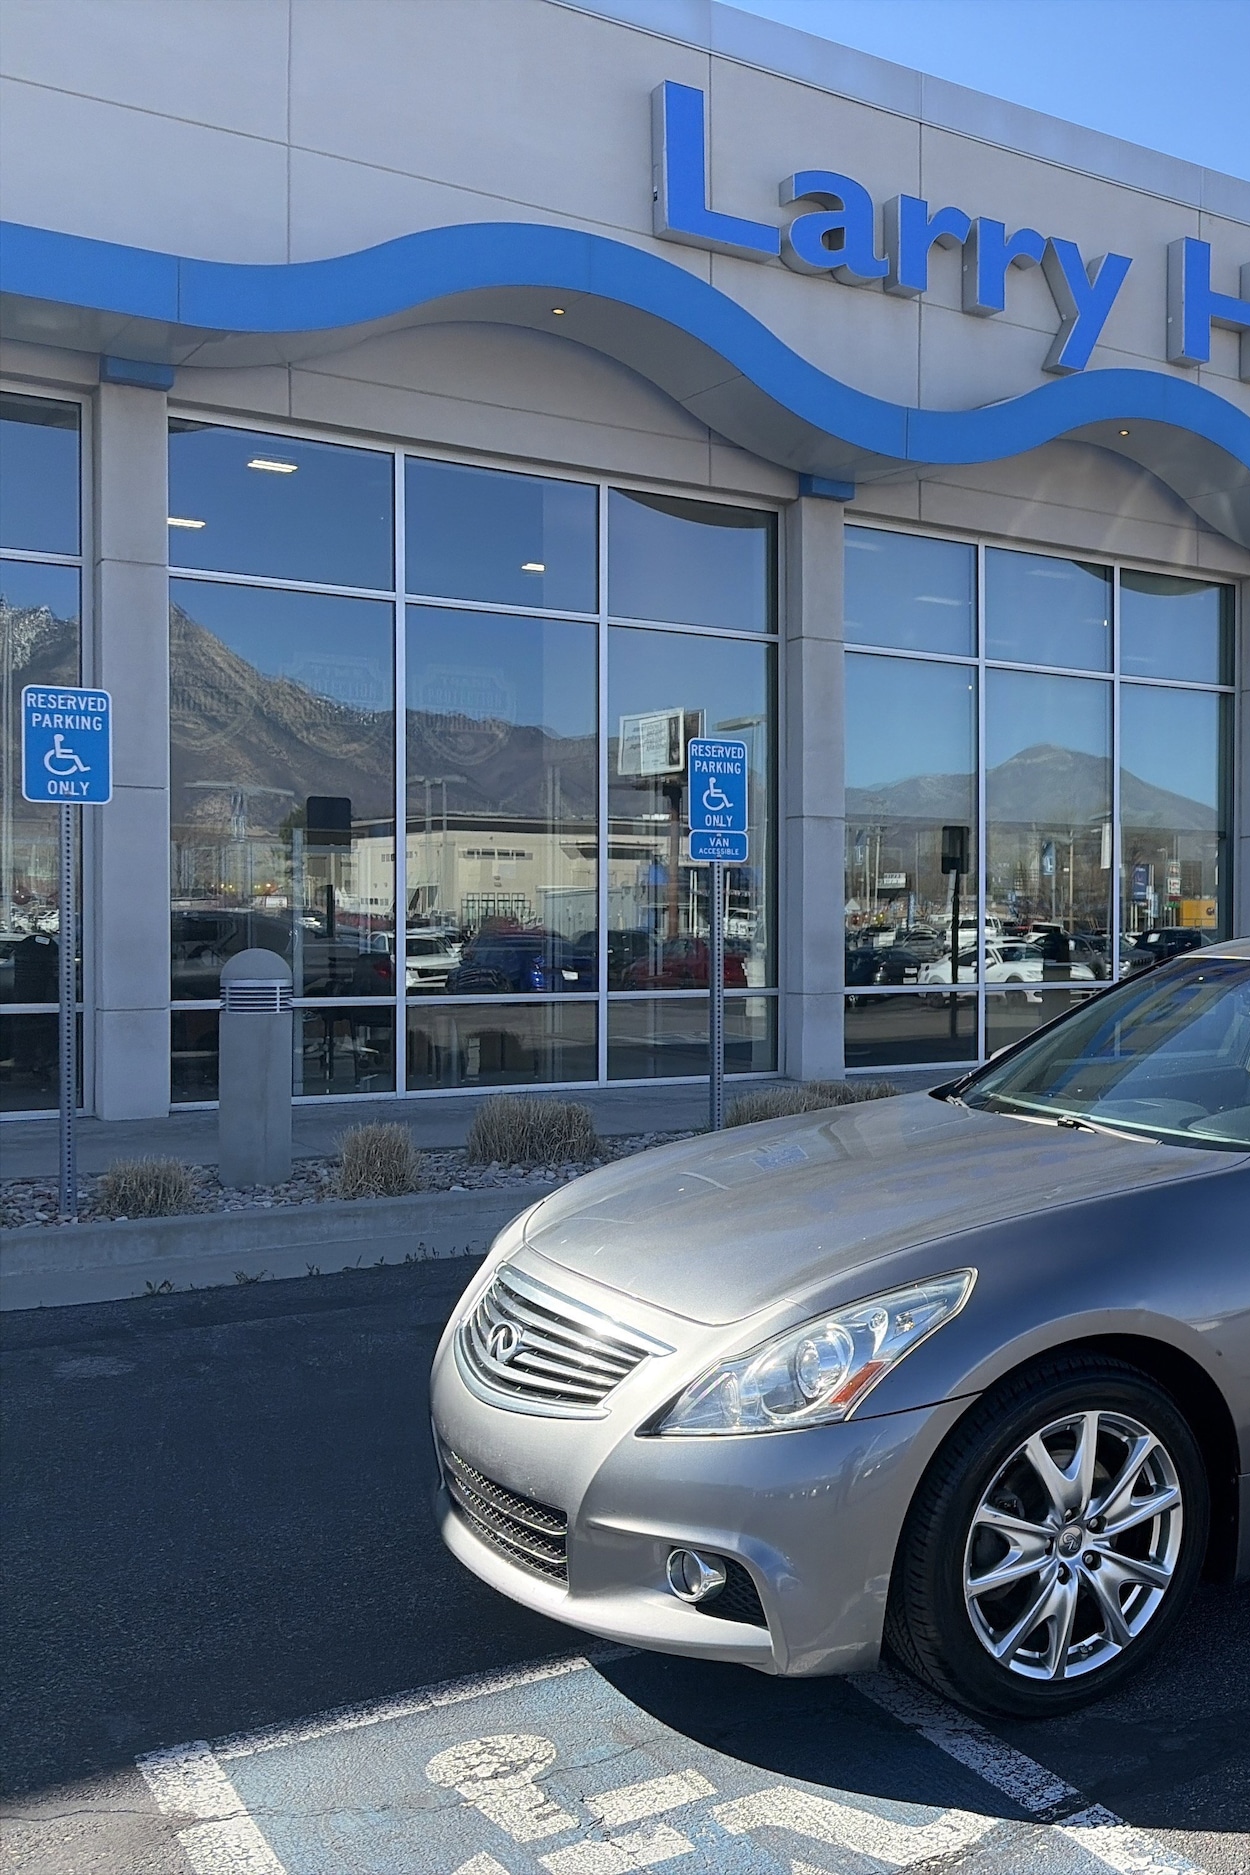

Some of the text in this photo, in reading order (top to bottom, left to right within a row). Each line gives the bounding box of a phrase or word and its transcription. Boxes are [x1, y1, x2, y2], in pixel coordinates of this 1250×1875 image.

[654, 80, 1132, 373] Larry
[26, 693, 107, 712] RESERVED
[31, 713, 103, 731] PARKING
[691, 744, 744, 759] RESERVED
[694, 761, 741, 774] PARKING
[47, 780, 90, 796] ONLY
[705, 814, 733, 828] ONLY
[709, 837, 730, 847] VAN
[698, 848, 740, 856] ACCESSIBLE
